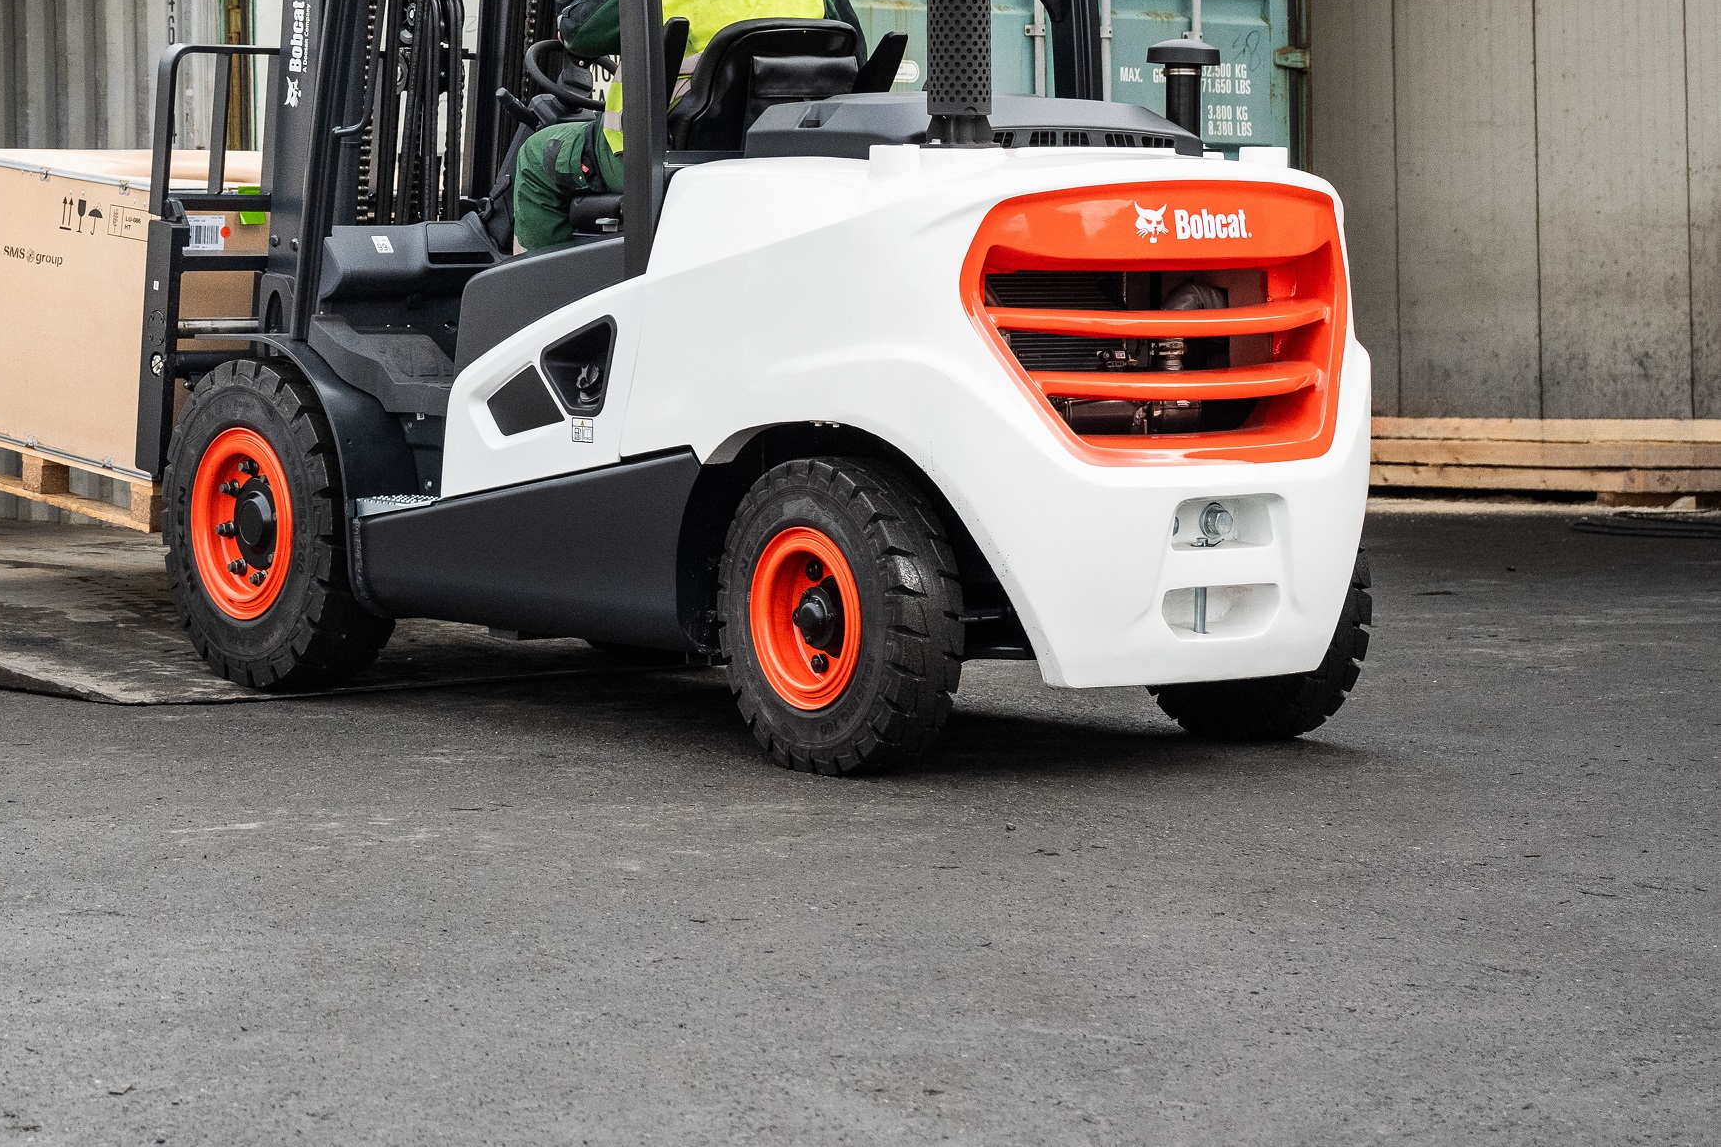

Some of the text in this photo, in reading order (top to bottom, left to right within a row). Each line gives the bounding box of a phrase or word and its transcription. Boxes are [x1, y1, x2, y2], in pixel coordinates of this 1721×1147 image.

[304, 3, 312, 37] Company
[289, 0, 306, 73] Bobcat
[1120, 67, 1143, 83] MAX.
[1235, 64, 1247, 79] KG
[1202, 79, 1251, 95] 71.650 LBS
[1208, 105, 1249, 121] 3.800 KG
[1237, 122, 1253, 137] LBS
[1174, 209, 1248, 240] Bobcat
[4, 245, 64, 268] SMS group
